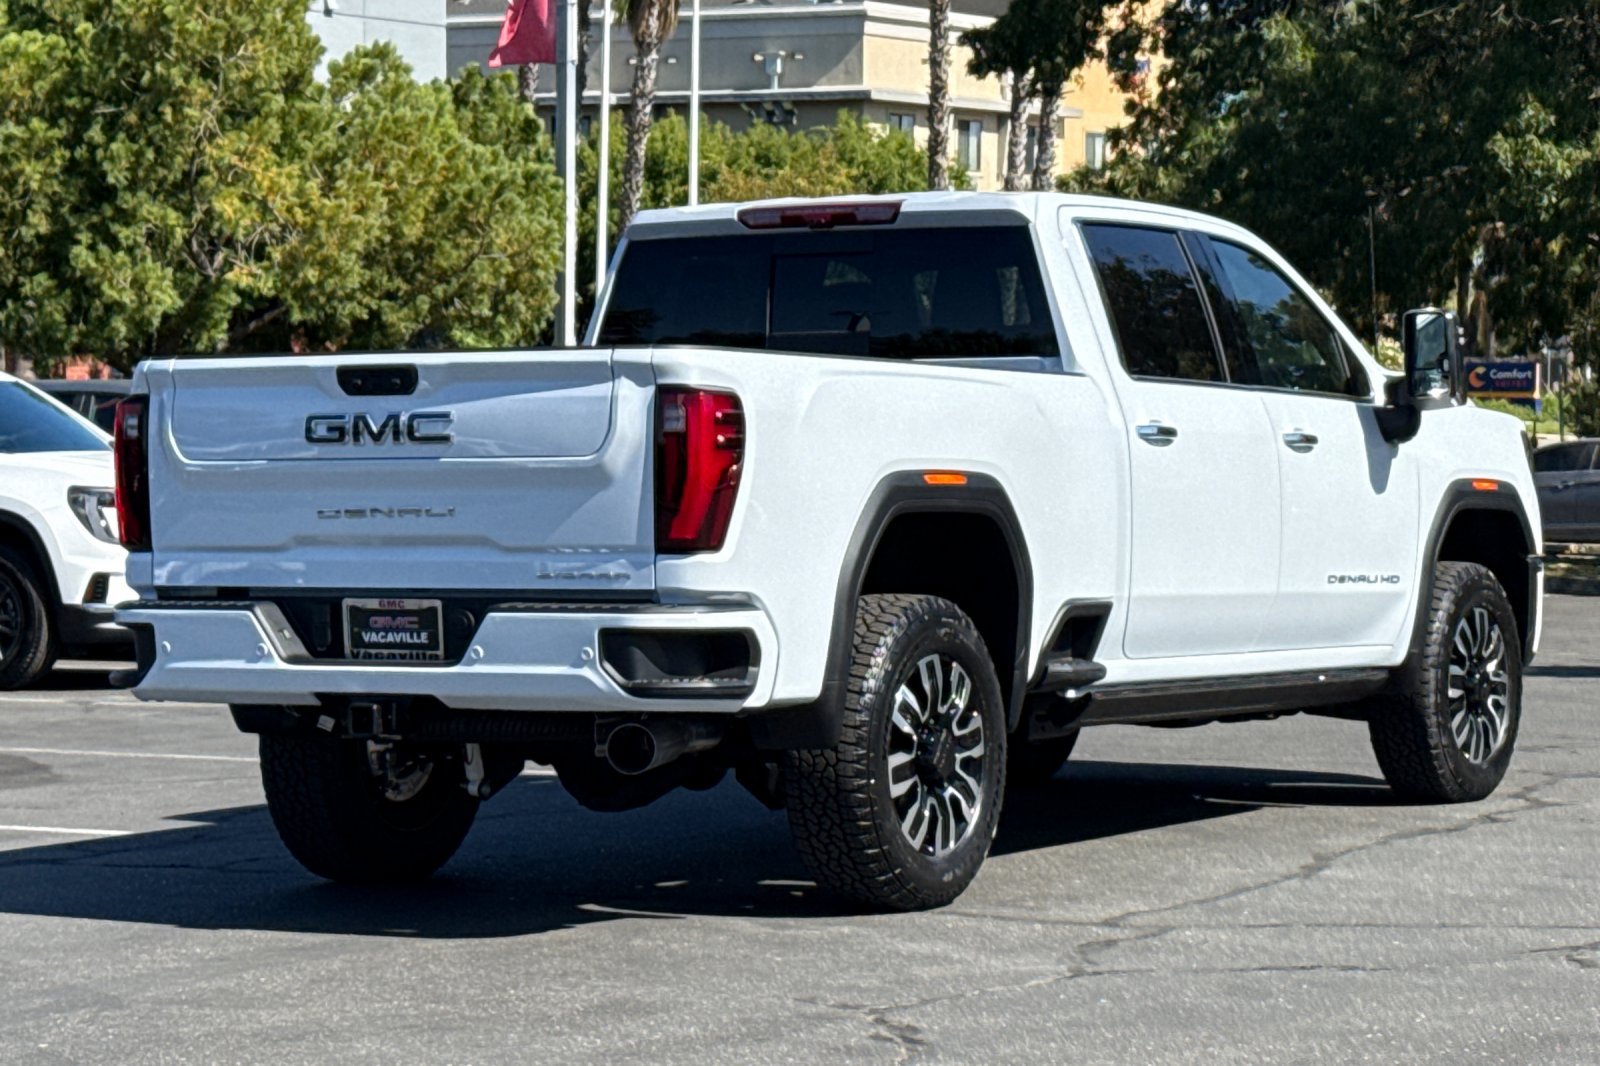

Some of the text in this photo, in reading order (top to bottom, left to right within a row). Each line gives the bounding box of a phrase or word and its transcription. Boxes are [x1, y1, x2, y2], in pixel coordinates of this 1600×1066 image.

[1489, 368, 1533, 380] Comfort
[304, 410, 456, 446] GMC
[316, 506, 456, 520] DENALI
[1327, 574, 1401, 584] DENALI HD
[378, 599, 406, 609] GMC
[369, 616, 419, 630] GMC
[361, 631, 429, 644] VACAVILLE
